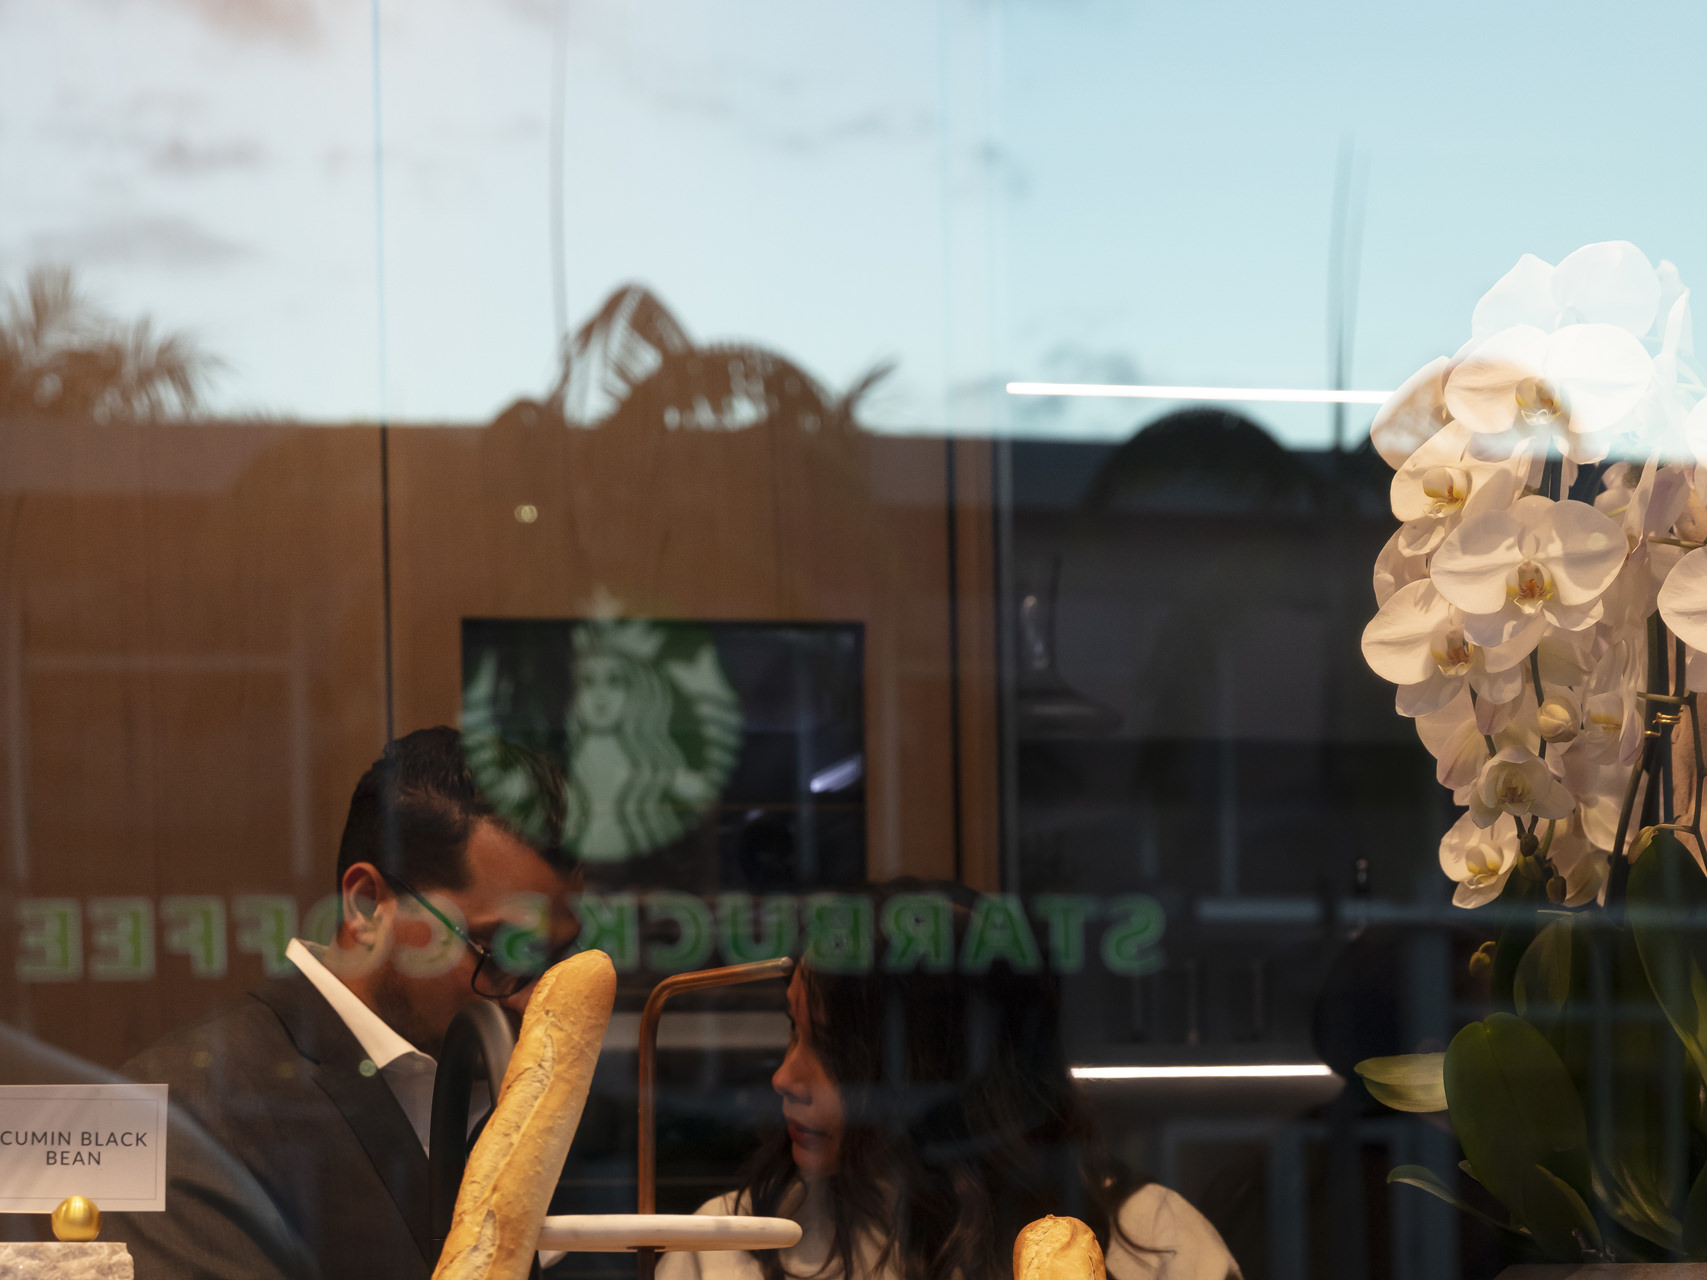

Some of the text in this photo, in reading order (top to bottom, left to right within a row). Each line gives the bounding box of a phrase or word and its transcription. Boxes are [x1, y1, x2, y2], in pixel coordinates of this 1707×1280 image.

[0, 1130, 148, 1147] CUMIN BLACK
[46, 1150, 101, 1166] BEAN
